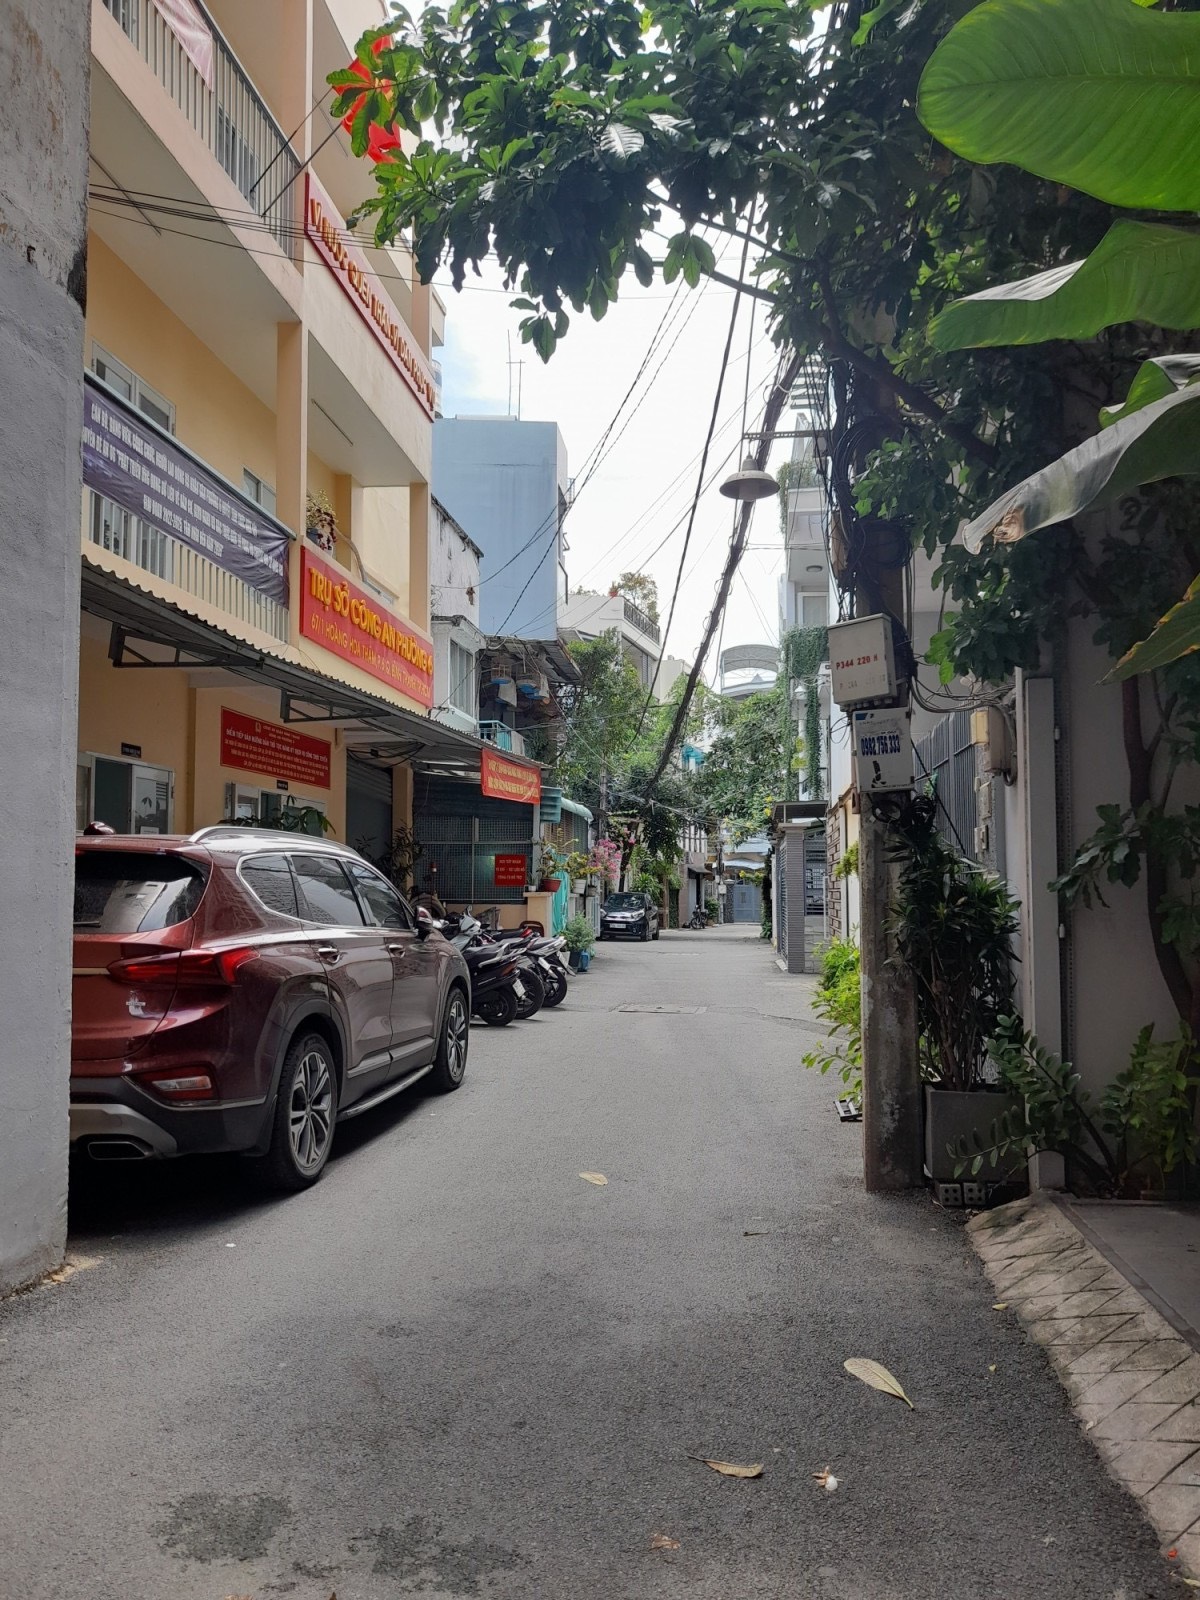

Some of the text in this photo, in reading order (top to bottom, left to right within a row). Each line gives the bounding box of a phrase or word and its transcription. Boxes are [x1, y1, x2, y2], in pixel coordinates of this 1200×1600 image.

[309, 567, 332, 612] TRỤ
[334, 581, 350, 617] SỞ
[350, 598, 381, 639] CÔNG
[382, 622, 396, 650] AN
[396, 630, 427, 671] PHƯỜNG
[325, 622, 348, 648] HOÀNG
[350, 638, 361, 659] HOA
[836, 659, 854, 671] P344
[857, 656, 870, 665] 220
